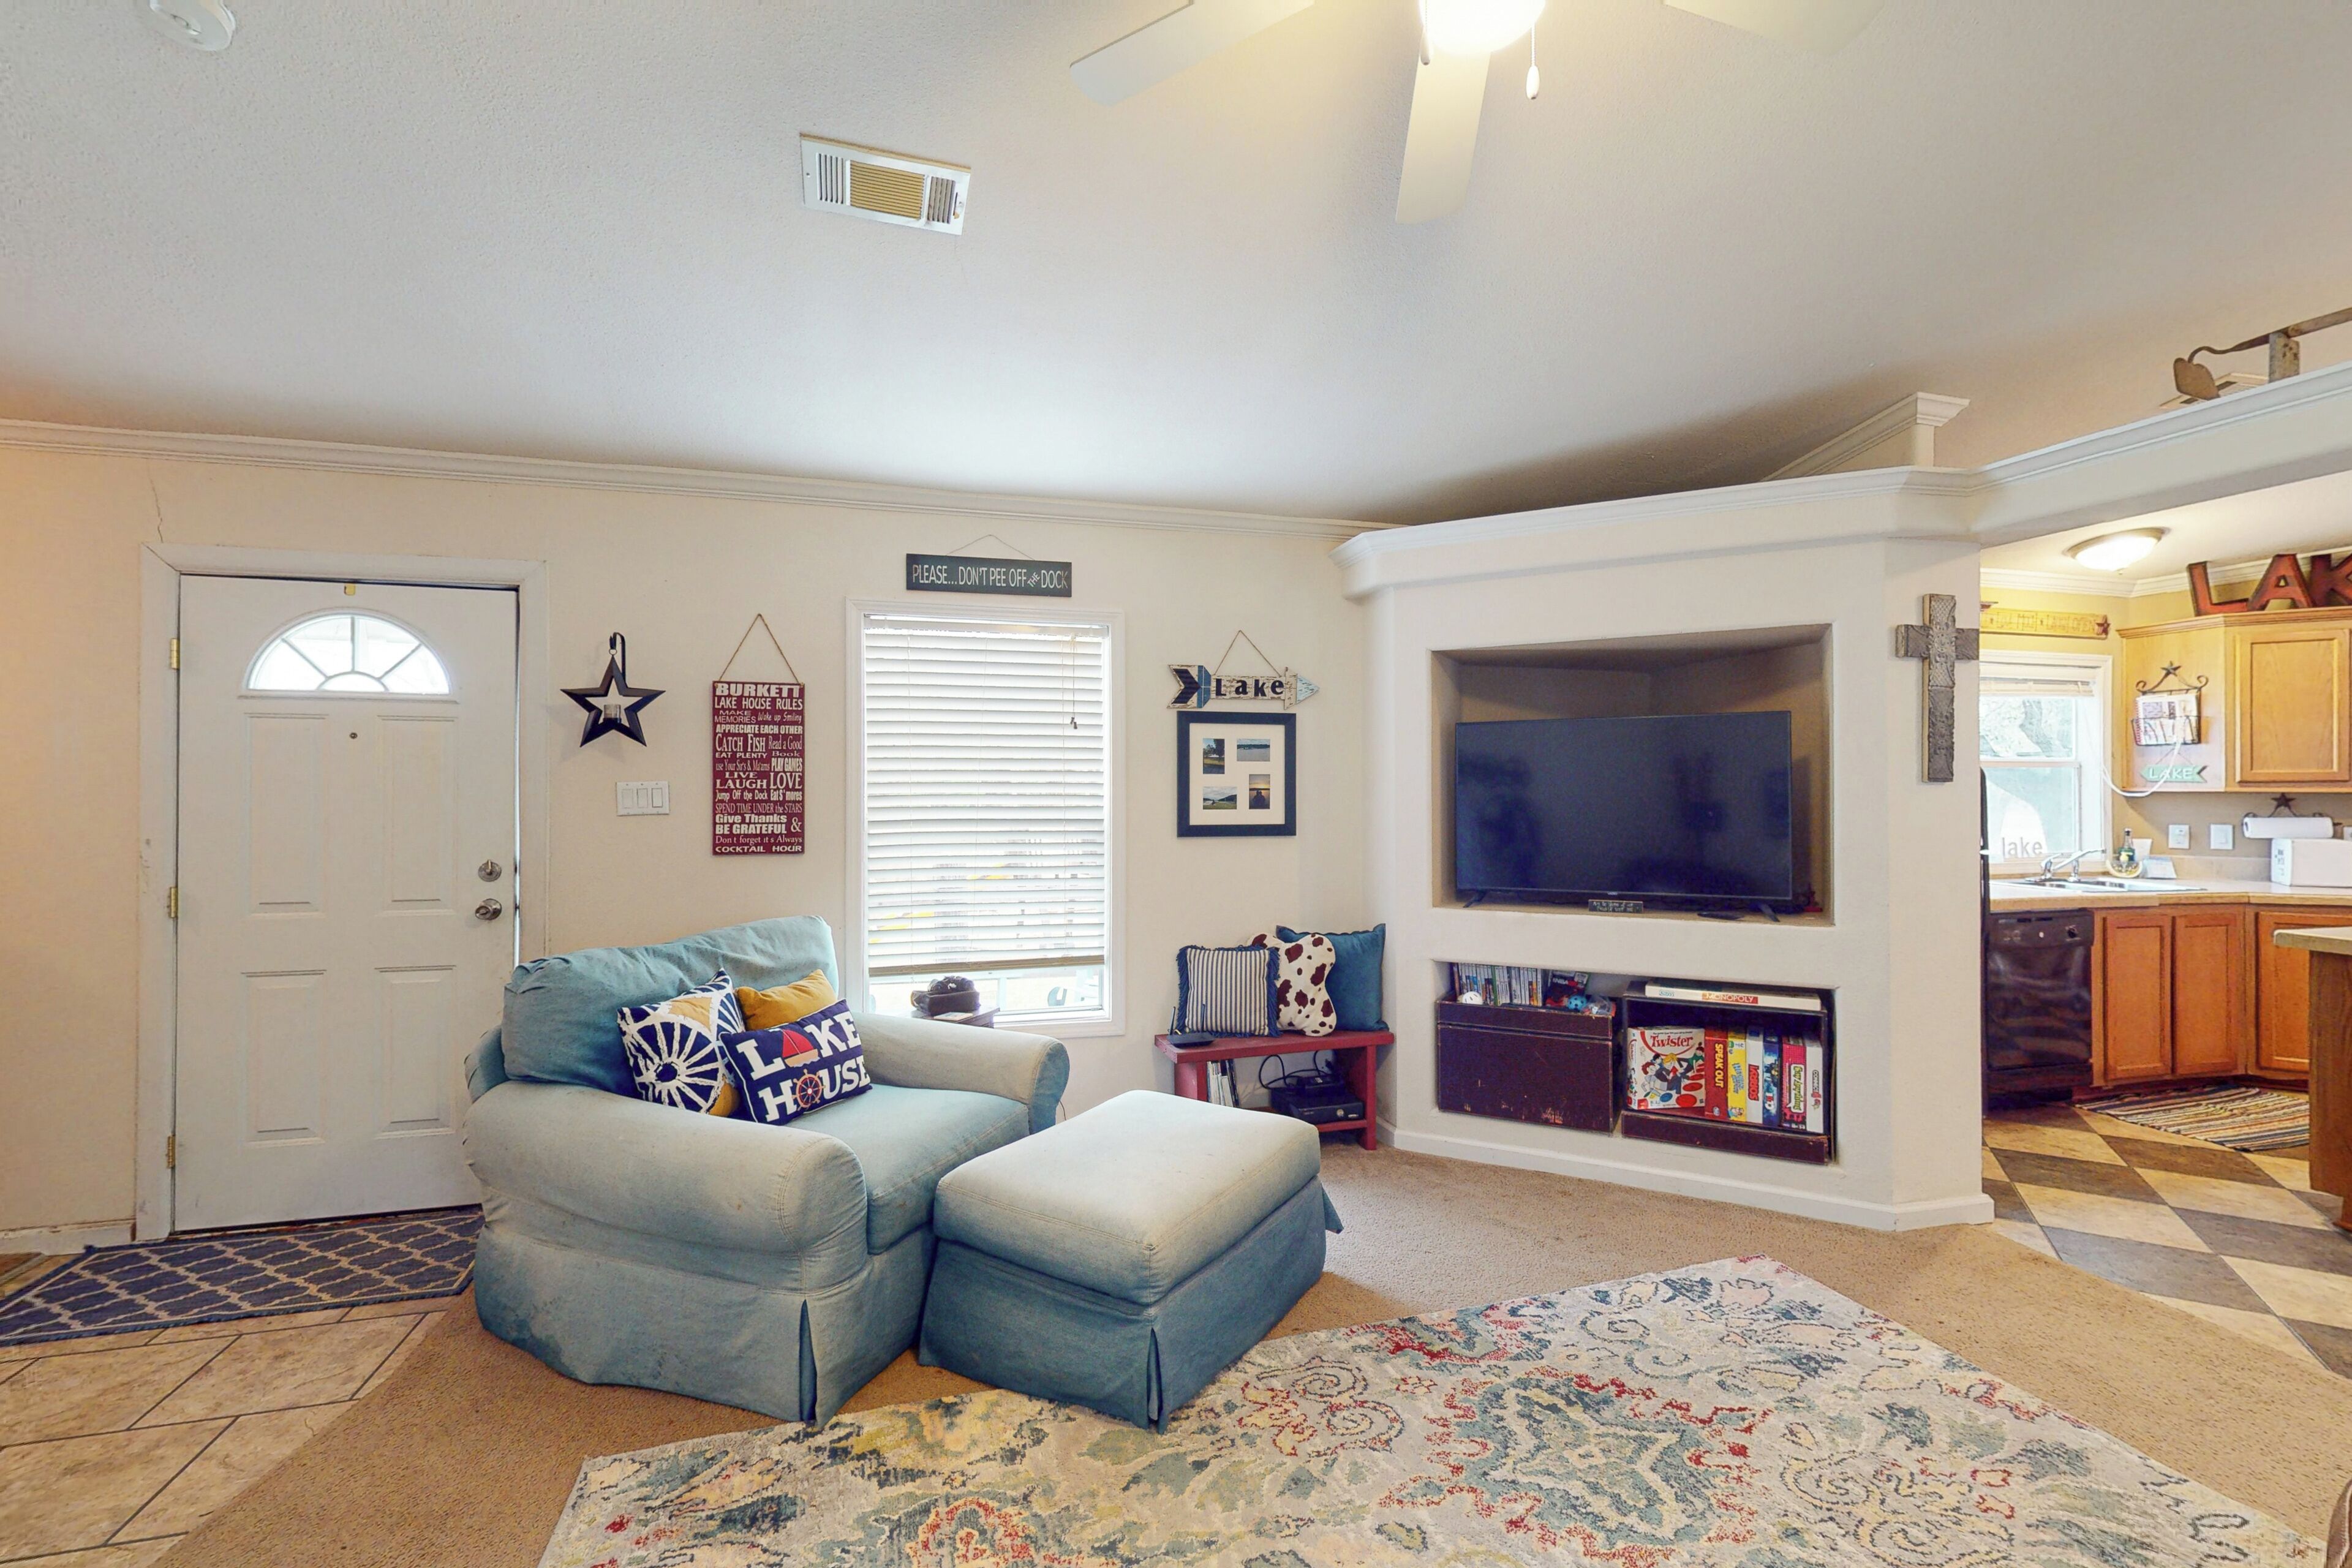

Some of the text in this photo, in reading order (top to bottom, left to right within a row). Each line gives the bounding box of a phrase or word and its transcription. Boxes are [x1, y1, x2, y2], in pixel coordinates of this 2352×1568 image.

[989, 568, 1006, 587] PEE
[1009, 568, 1027, 588] OFF
[1027, 571, 1041, 587] THE
[1041, 570, 1068, 589] DOCK
[715, 683, 800, 697] BURKETT
[1215, 678, 1284, 698] Lake
[714, 696, 803, 710] LAKE HOUSE RULES
[757, 711, 802, 724] Wake up Smiling
[715, 724, 803, 734] APPRECIATE EACH OTHER
[768, 734, 802, 750] Read a Good
[747, 760, 752, 771] &
[771, 758, 803, 772] PLAY GAMES
[2149, 767, 2193, 780] LAKE
[715, 779, 767, 789] LAUGH
[770, 772, 802, 789] LOVE
[715, 790, 768, 802] Jump Off the Dock
[770, 790, 778, 801] Eat
[715, 803, 802, 813] SPEND TIME UNDER the STARS
[715, 813, 802, 832] Give Thanks &
[715, 824, 787, 834] BE GRATEFUL
[739, 835, 761, 846] forget
[776, 834, 802, 845] Always
[2002, 837, 2043, 858] lake
[1706, 992, 1754, 1003] MONOPOLY
[1650, 1035, 1694, 1047] Twister
[1715, 1043, 1724, 1088] SPEAK OUT
